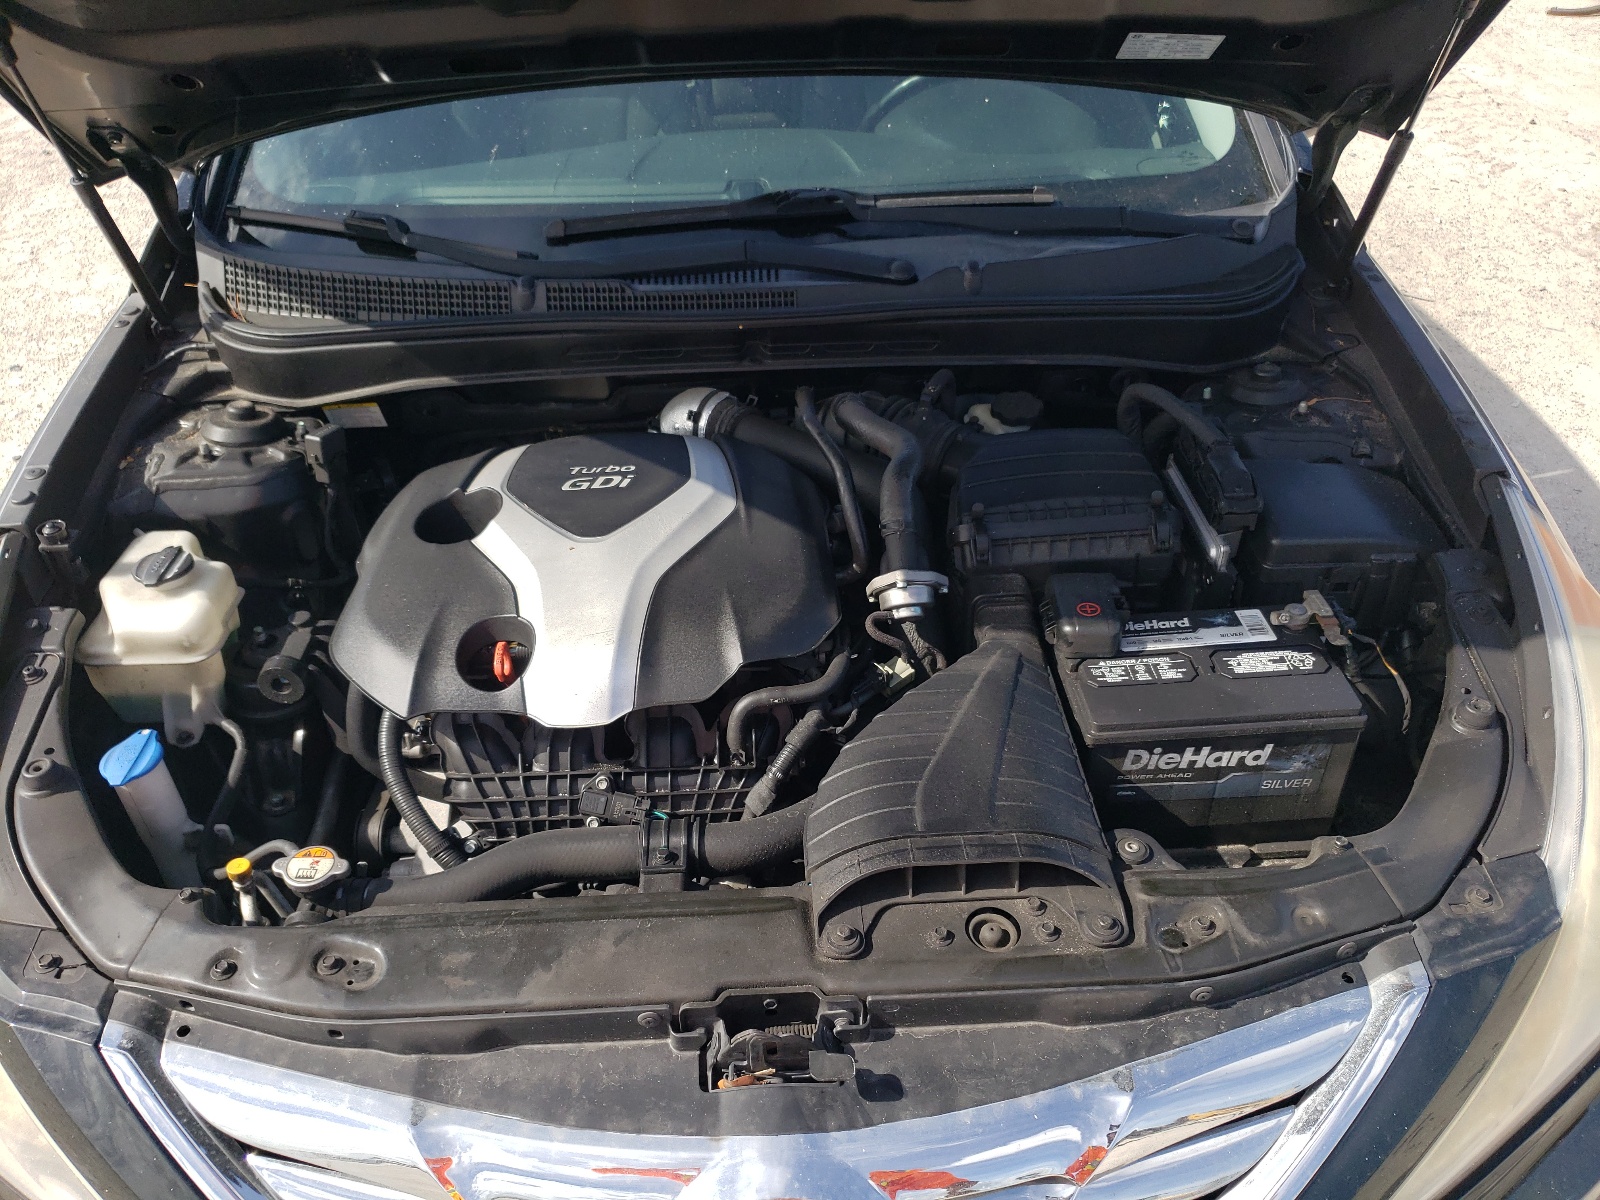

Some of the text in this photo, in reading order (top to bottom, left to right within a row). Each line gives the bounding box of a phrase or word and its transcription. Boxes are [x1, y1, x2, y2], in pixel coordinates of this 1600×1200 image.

[569, 464, 636, 475] Turbo
[561, 474, 636, 491] GDi
[1121, 743, 1275, 771] DieHard
[1260, 778, 1313, 790] SILVER
